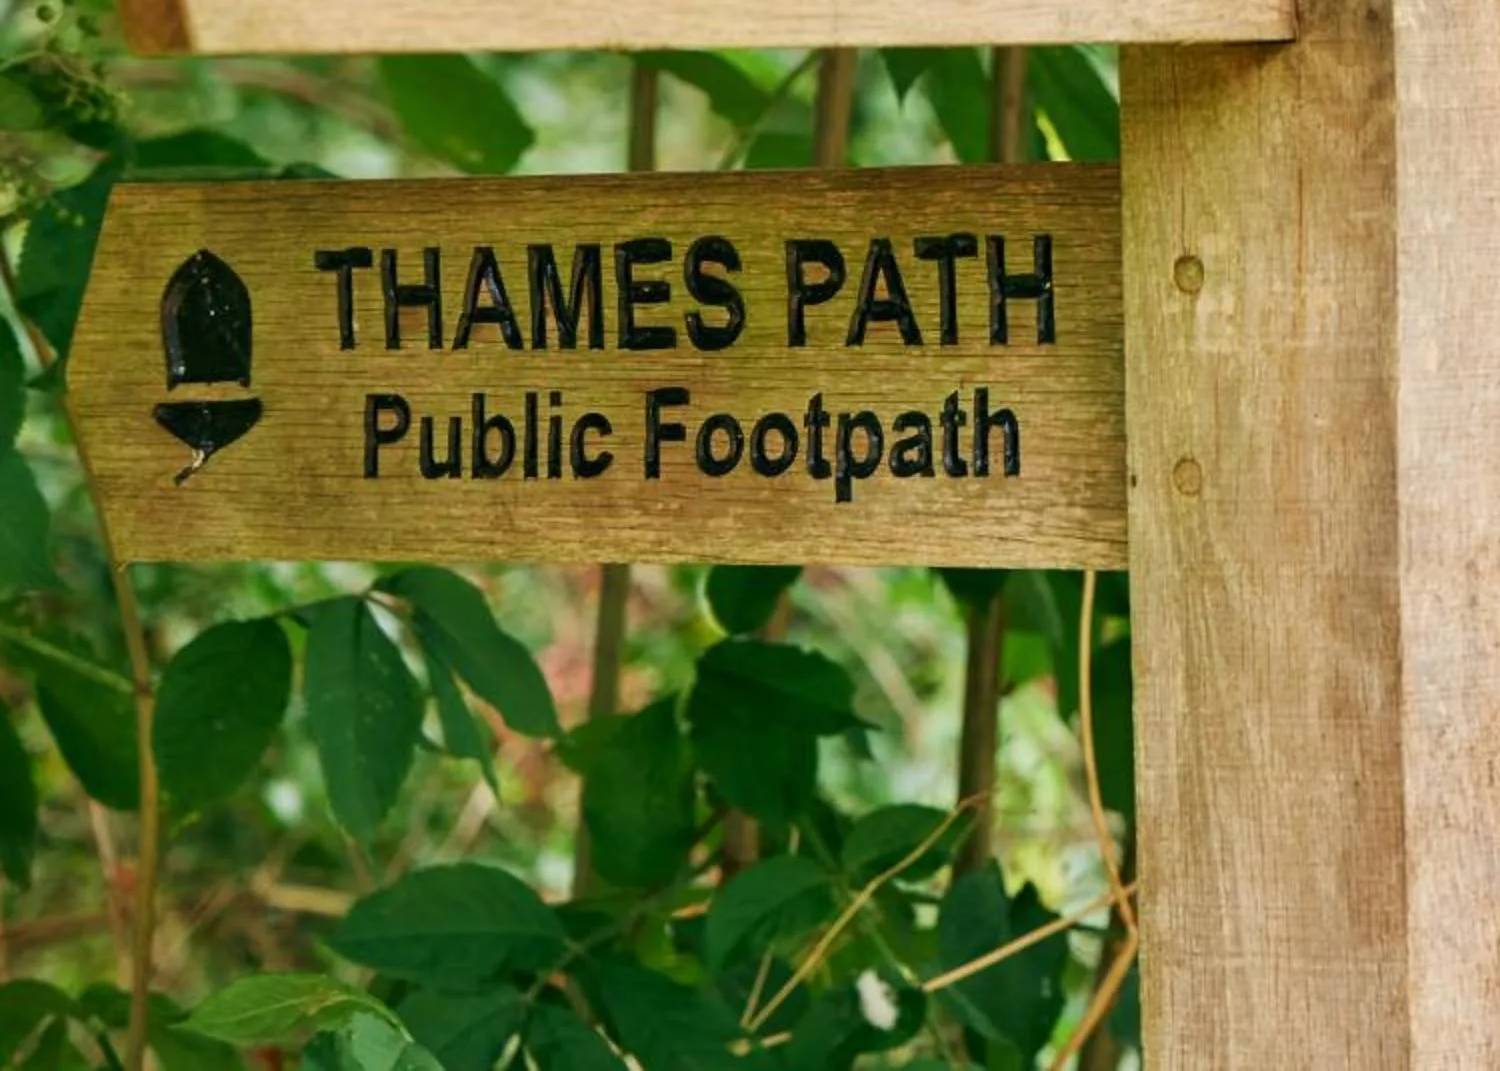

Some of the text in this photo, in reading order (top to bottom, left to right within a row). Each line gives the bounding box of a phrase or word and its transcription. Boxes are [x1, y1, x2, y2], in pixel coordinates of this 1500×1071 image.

[314, 231, 1058, 352] THAMES PATH
[362, 386, 1021, 503] Public Footpath
